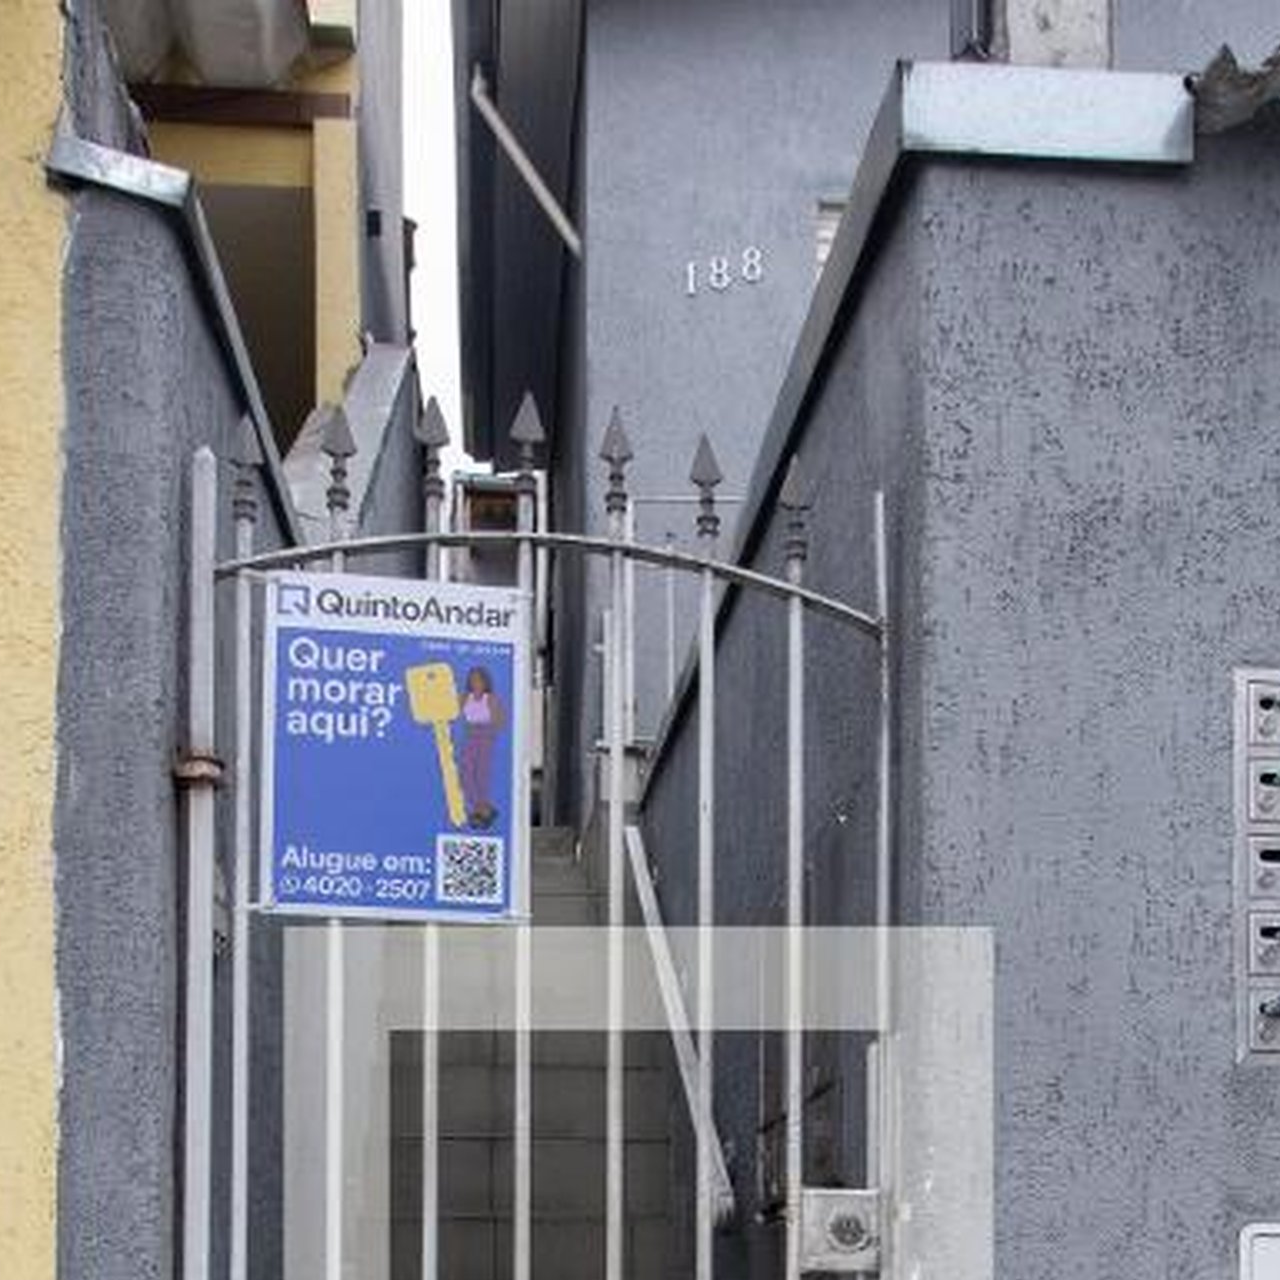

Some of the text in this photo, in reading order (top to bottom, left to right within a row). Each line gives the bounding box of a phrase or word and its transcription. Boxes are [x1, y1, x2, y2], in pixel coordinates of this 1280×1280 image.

[686, 246, 762, 295] 188
[316, 589, 516, 628] QuintoAndar
[288, 637, 384, 672] Quer
[287, 676, 402, 705] morar
[286, 706, 392, 743] aqui?
[281, 845, 377, 875] Alugue
[303, 875, 431, 900] 4020 2507
